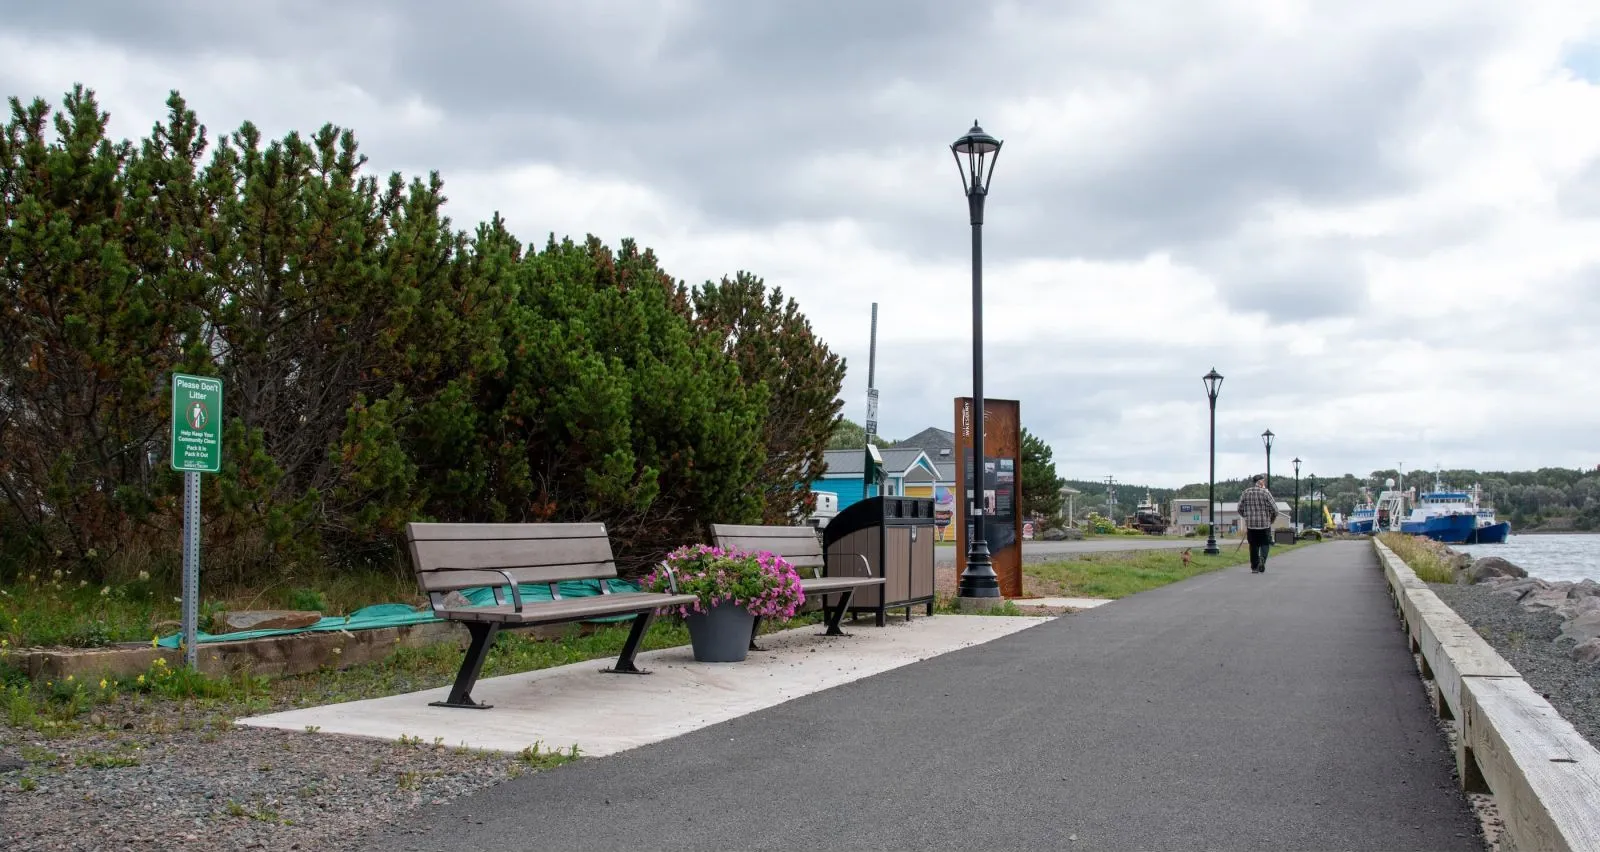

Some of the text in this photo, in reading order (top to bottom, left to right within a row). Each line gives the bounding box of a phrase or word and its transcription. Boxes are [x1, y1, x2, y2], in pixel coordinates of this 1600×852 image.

[178, 380, 218, 392] Please Don't
[189, 391, 207, 400] Litter
[178, 436, 203, 444] Community
